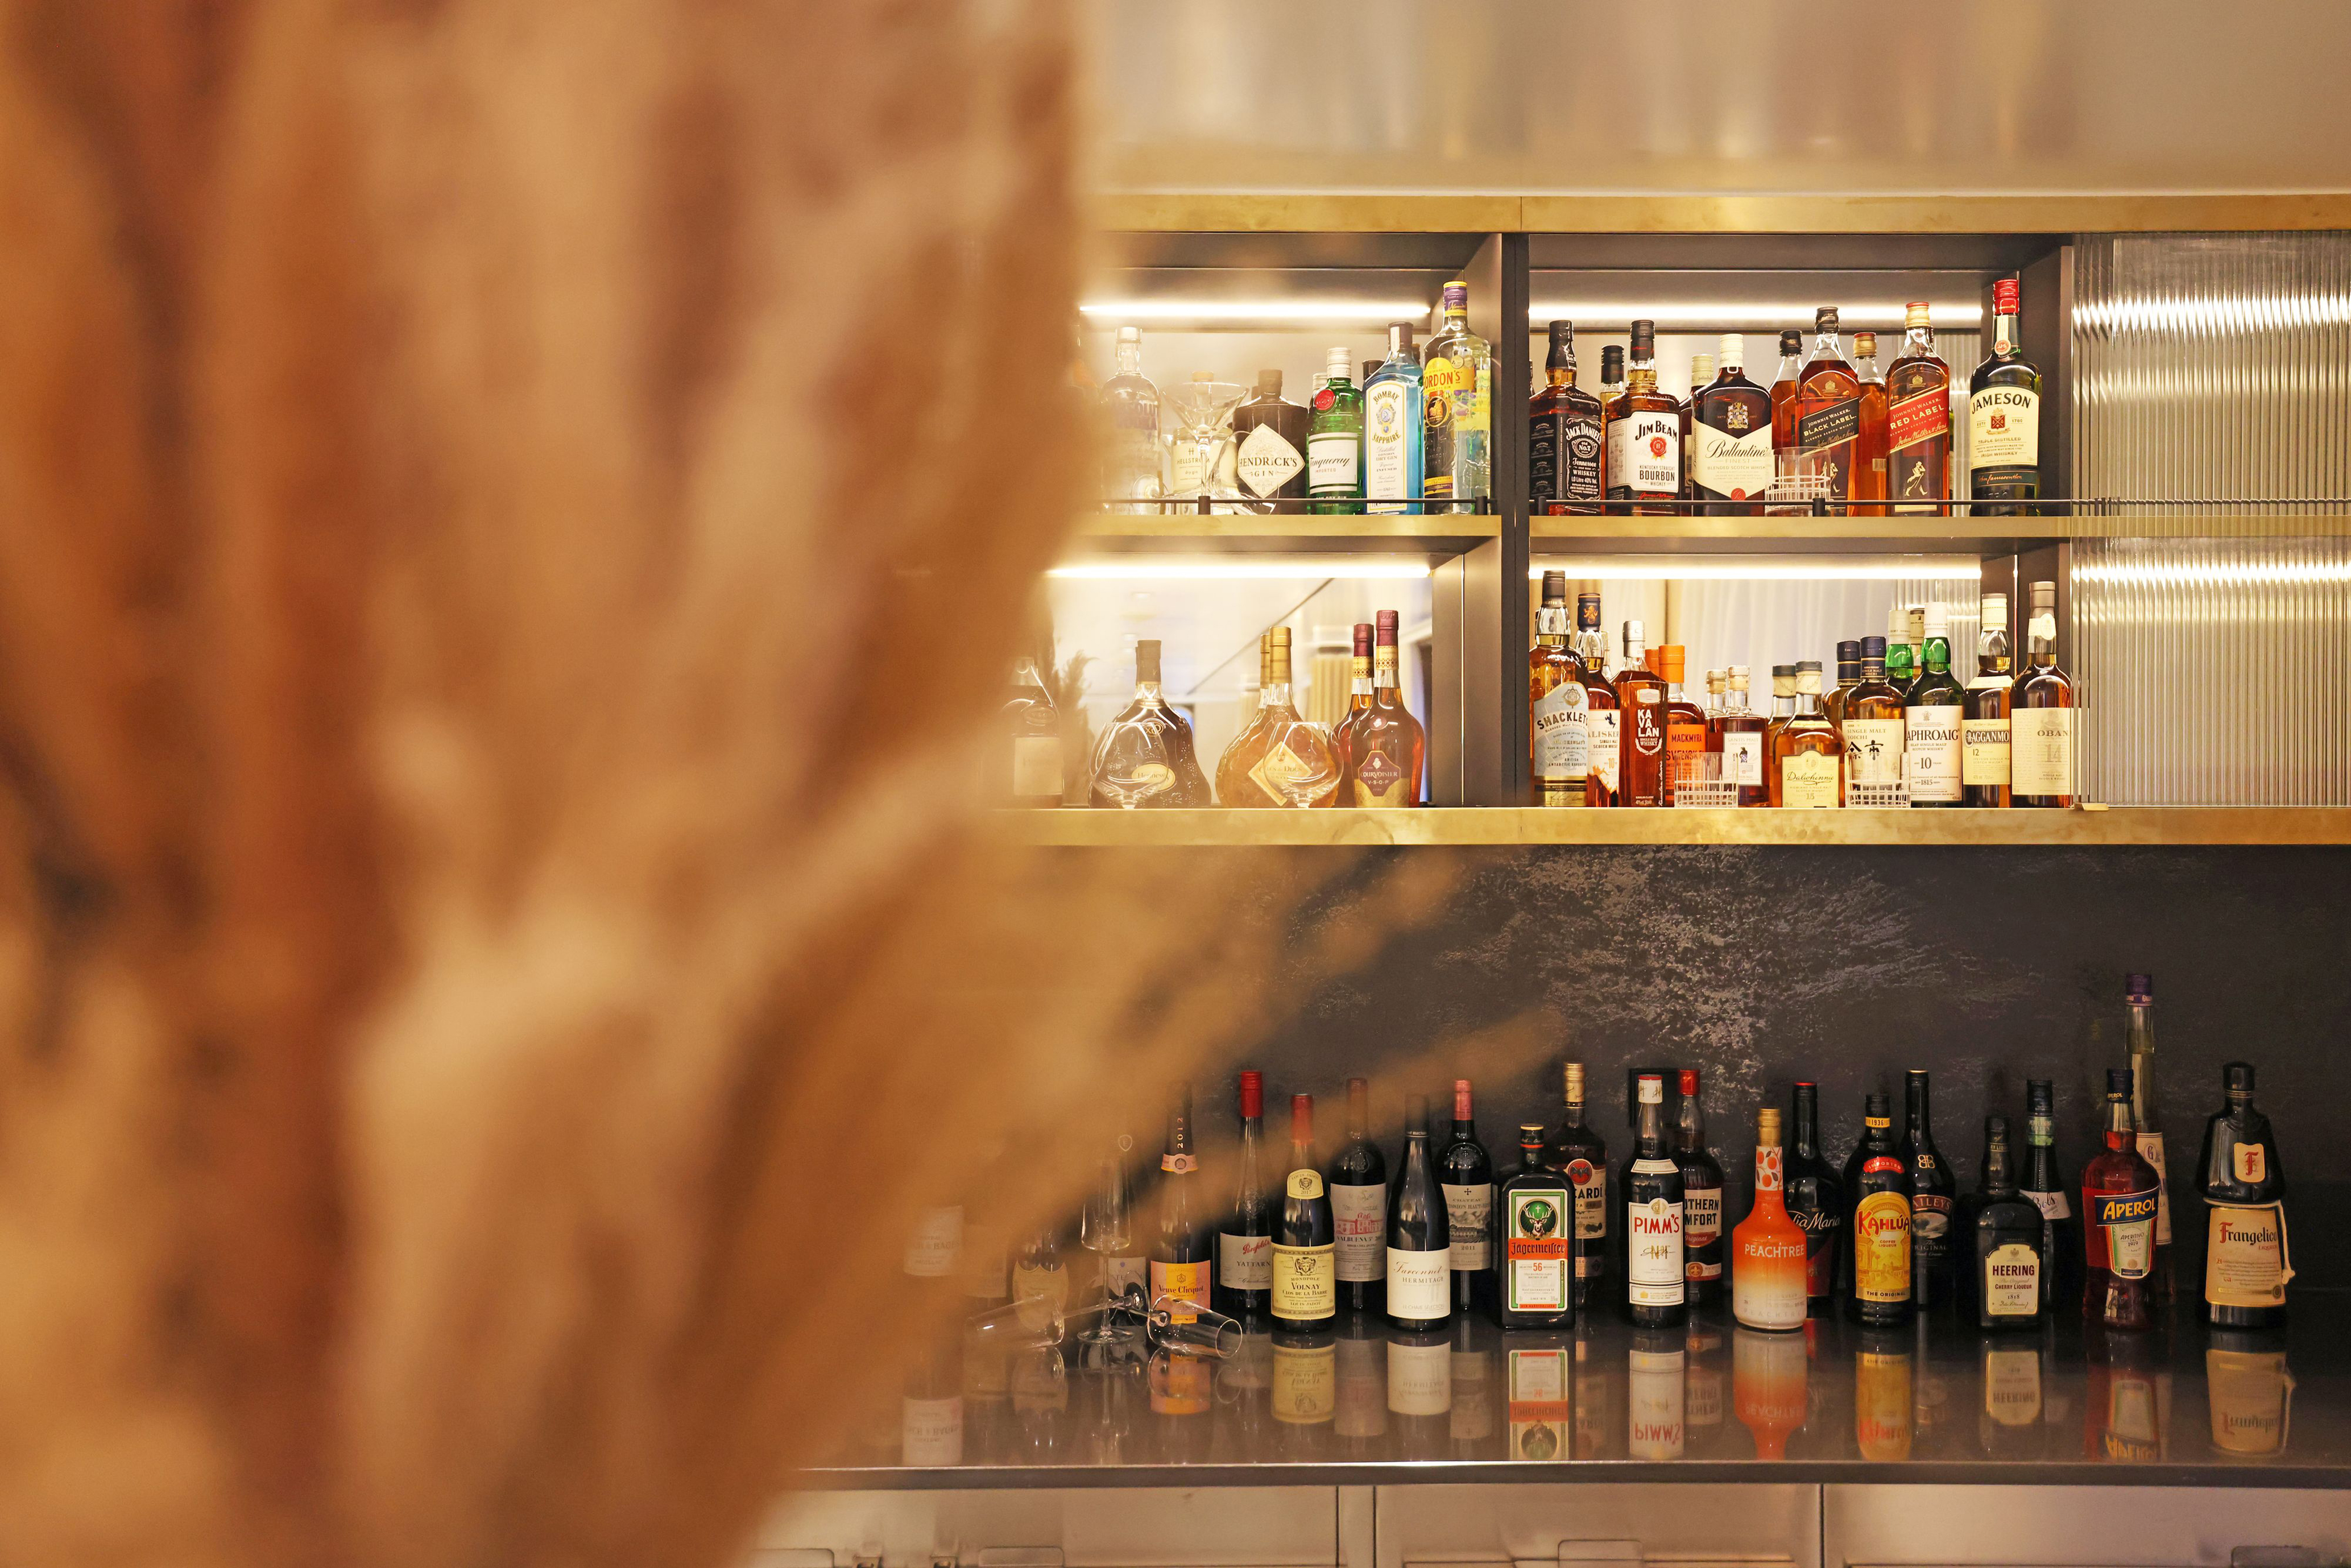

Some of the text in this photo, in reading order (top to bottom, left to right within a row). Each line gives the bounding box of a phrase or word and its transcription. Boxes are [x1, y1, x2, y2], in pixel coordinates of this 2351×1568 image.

[1373, 391, 1399, 404] BOMBAY
[1972, 393, 2031, 414] JAMESON
[1890, 404, 1944, 429] RED LABEL
[1893, 407, 1916, 420] JOHNNIE
[1808, 416, 1829, 428] JOHNNIE
[1565, 425, 1580, 440] JACK
[1635, 420, 1677, 442] JIM BEAM
[1804, 424, 1828, 436] BLACK
[1372, 432, 1401, 444] SAPPHIRE
[1572, 458, 1596, 467] Tennessee
[1640, 470, 1675, 481] BOURBON
[1637, 709, 1652, 719] KA
[1637, 718, 1653, 728] VA
[1638, 727, 1659, 737] LAN
[1671, 734, 1702, 742] MACKMYRA
[1906, 729, 1958, 740] APHROAIG
[1666, 750, 1697, 760] SVENSK
[2045, 744, 2062, 763] 14
[1608, 758, 1615, 768] 10
[1920, 757, 1931, 769] 10
[1787, 771, 1834, 781] Dalwhinnie
[1575, 1184, 1603, 1199] CARDÍ
[1685, 1199, 1719, 1210] UTHERN
[2103, 1198, 2155, 1220] APEROL
[1634, 1214, 1679, 1234] PIMM'S
[1685, 1213, 1717, 1226] MFORT
[1805, 1213, 1840, 1230] Maria
[1858, 1210, 1910, 1236] KAHLÚA
[2219, 1222, 2277, 1246] Frangelico
[1745, 1244, 1804, 1257] PEACHTREE
[1533, 1263, 1542, 1271] 56
[1993, 1265, 2035, 1276] HEERING
